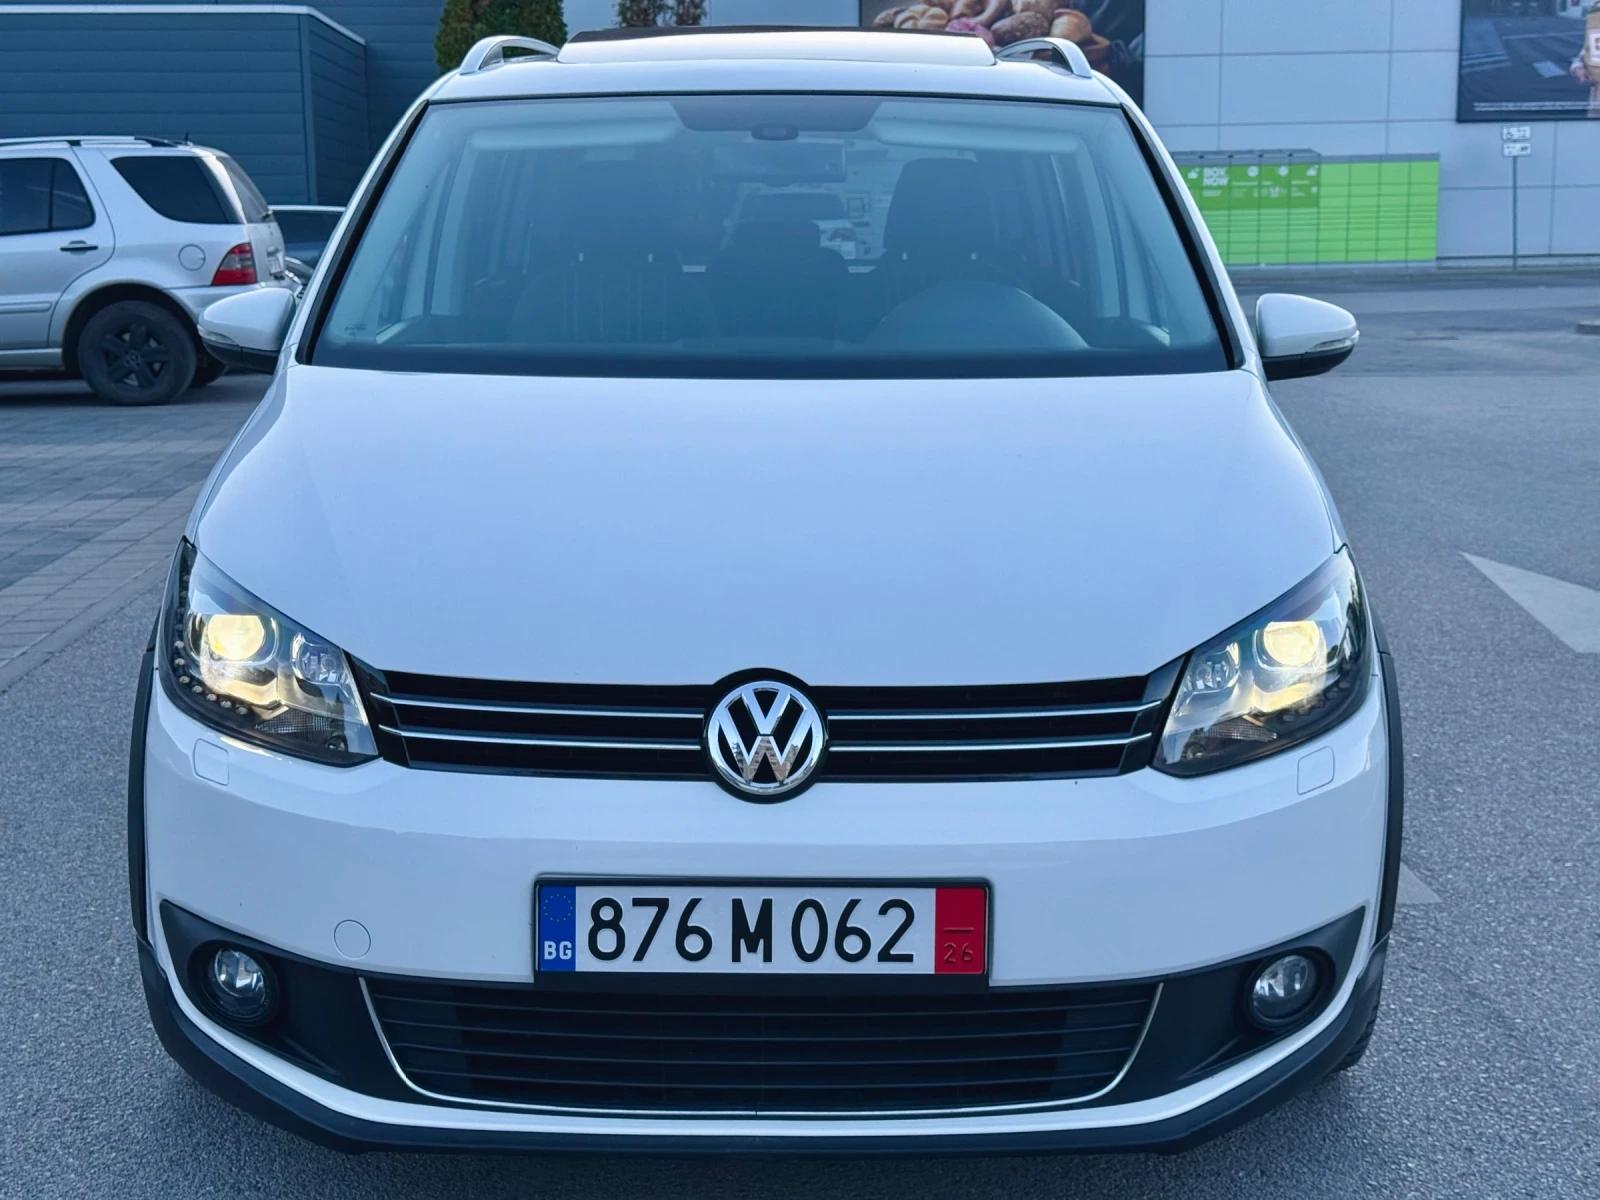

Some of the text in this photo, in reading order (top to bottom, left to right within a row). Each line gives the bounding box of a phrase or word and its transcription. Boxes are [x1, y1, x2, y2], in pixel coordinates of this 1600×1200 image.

[711, 683, 820, 791] VW
[544, 940, 572, 960] BG
[587, 897, 915, 964] 876 M 062
[944, 942, 974, 964] 26
